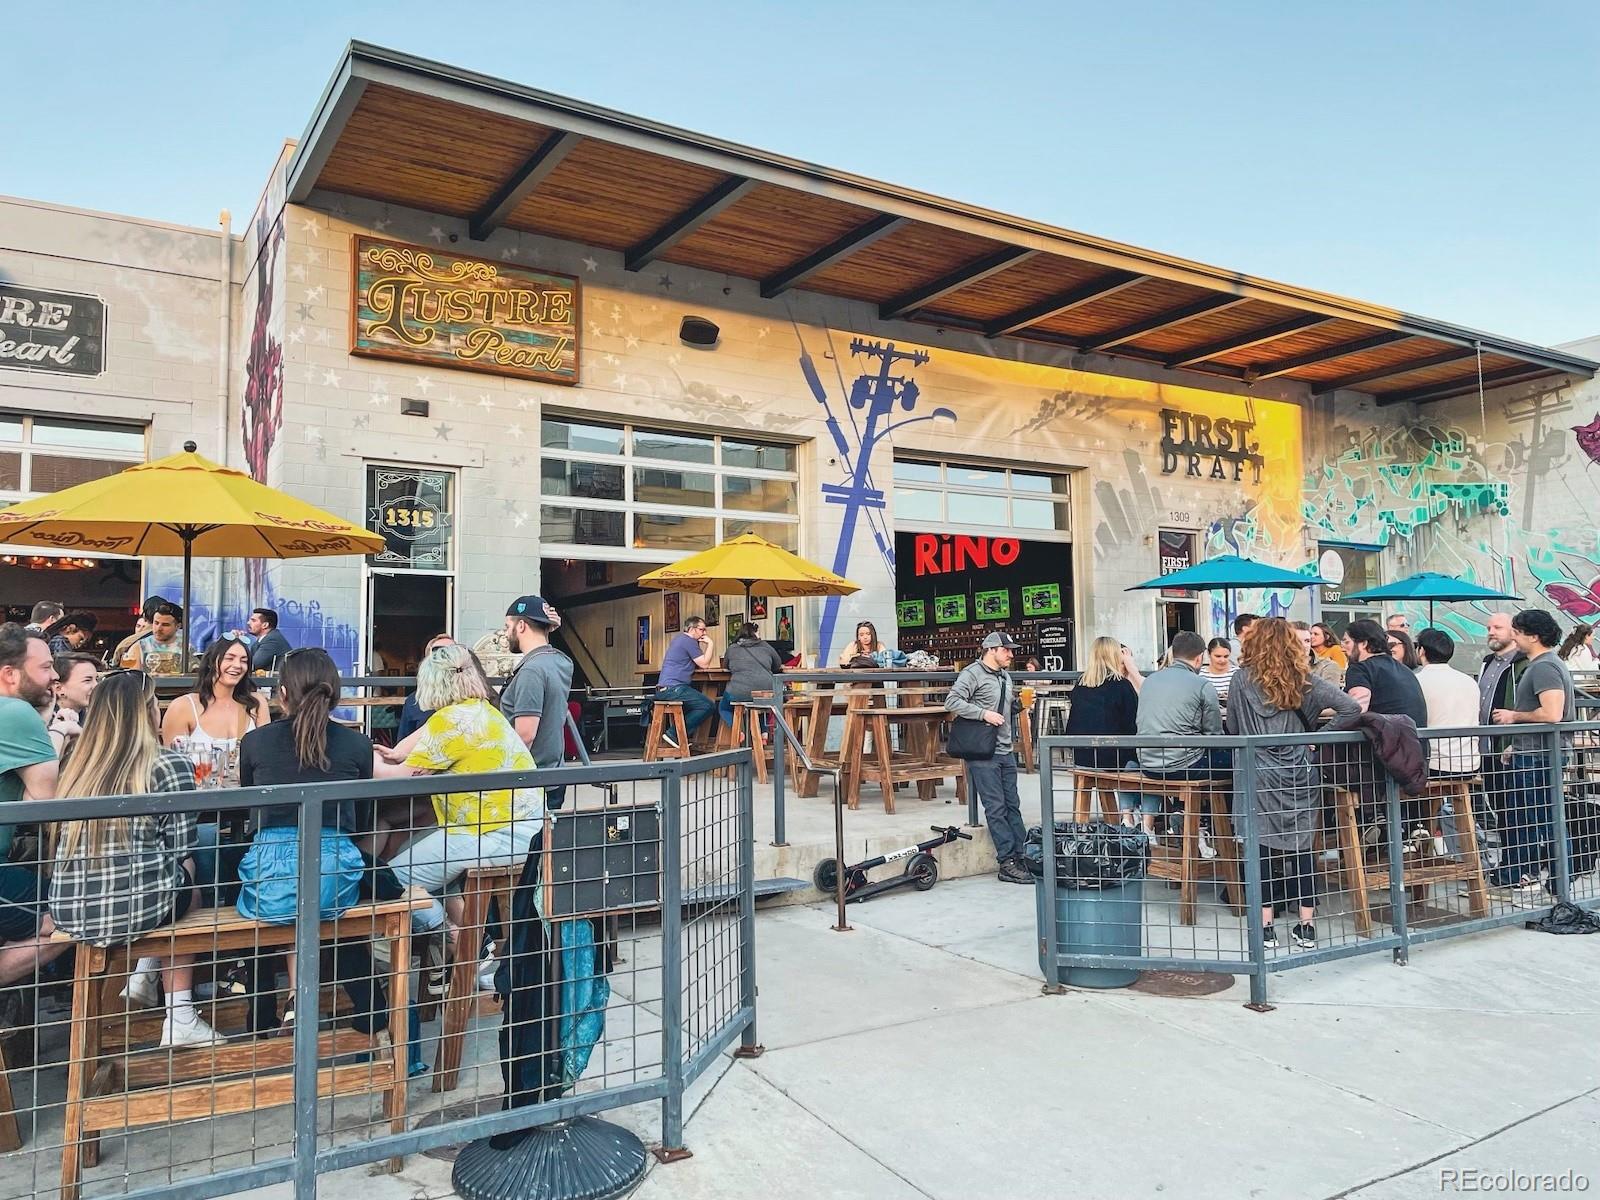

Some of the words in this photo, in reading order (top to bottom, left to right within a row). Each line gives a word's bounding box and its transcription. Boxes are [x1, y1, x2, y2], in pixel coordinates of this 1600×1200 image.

[0, 295, 73, 331] RE
[367, 276, 572, 347] LUSTRE
[455, 328, 568, 371] Pearl
[1162, 450, 1264, 485] DRAFT
[386, 507, 434, 528] 1315
[1169, 511, 1190, 523] 1309
[1324, 591, 1341, 602] 1307
